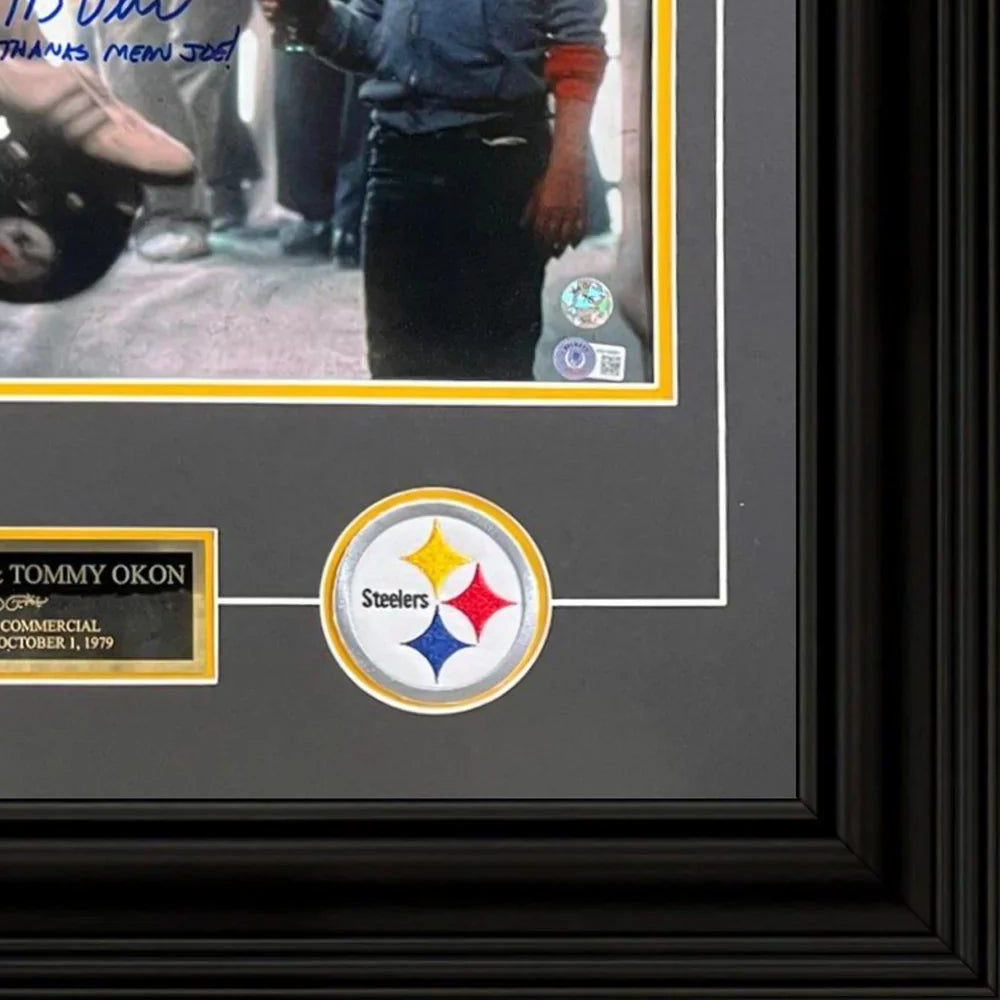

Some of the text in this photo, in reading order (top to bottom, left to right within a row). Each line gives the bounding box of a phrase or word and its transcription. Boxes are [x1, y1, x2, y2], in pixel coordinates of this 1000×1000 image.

[9, 563, 107, 585] TOMMY
[111, 563, 186, 586] OKON
[361, 588, 429, 609] Steelers
[0, 619, 102, 633] COMMERCIAL
[69, 636, 81, 651] 1,
[85, 636, 114, 650] 1979
